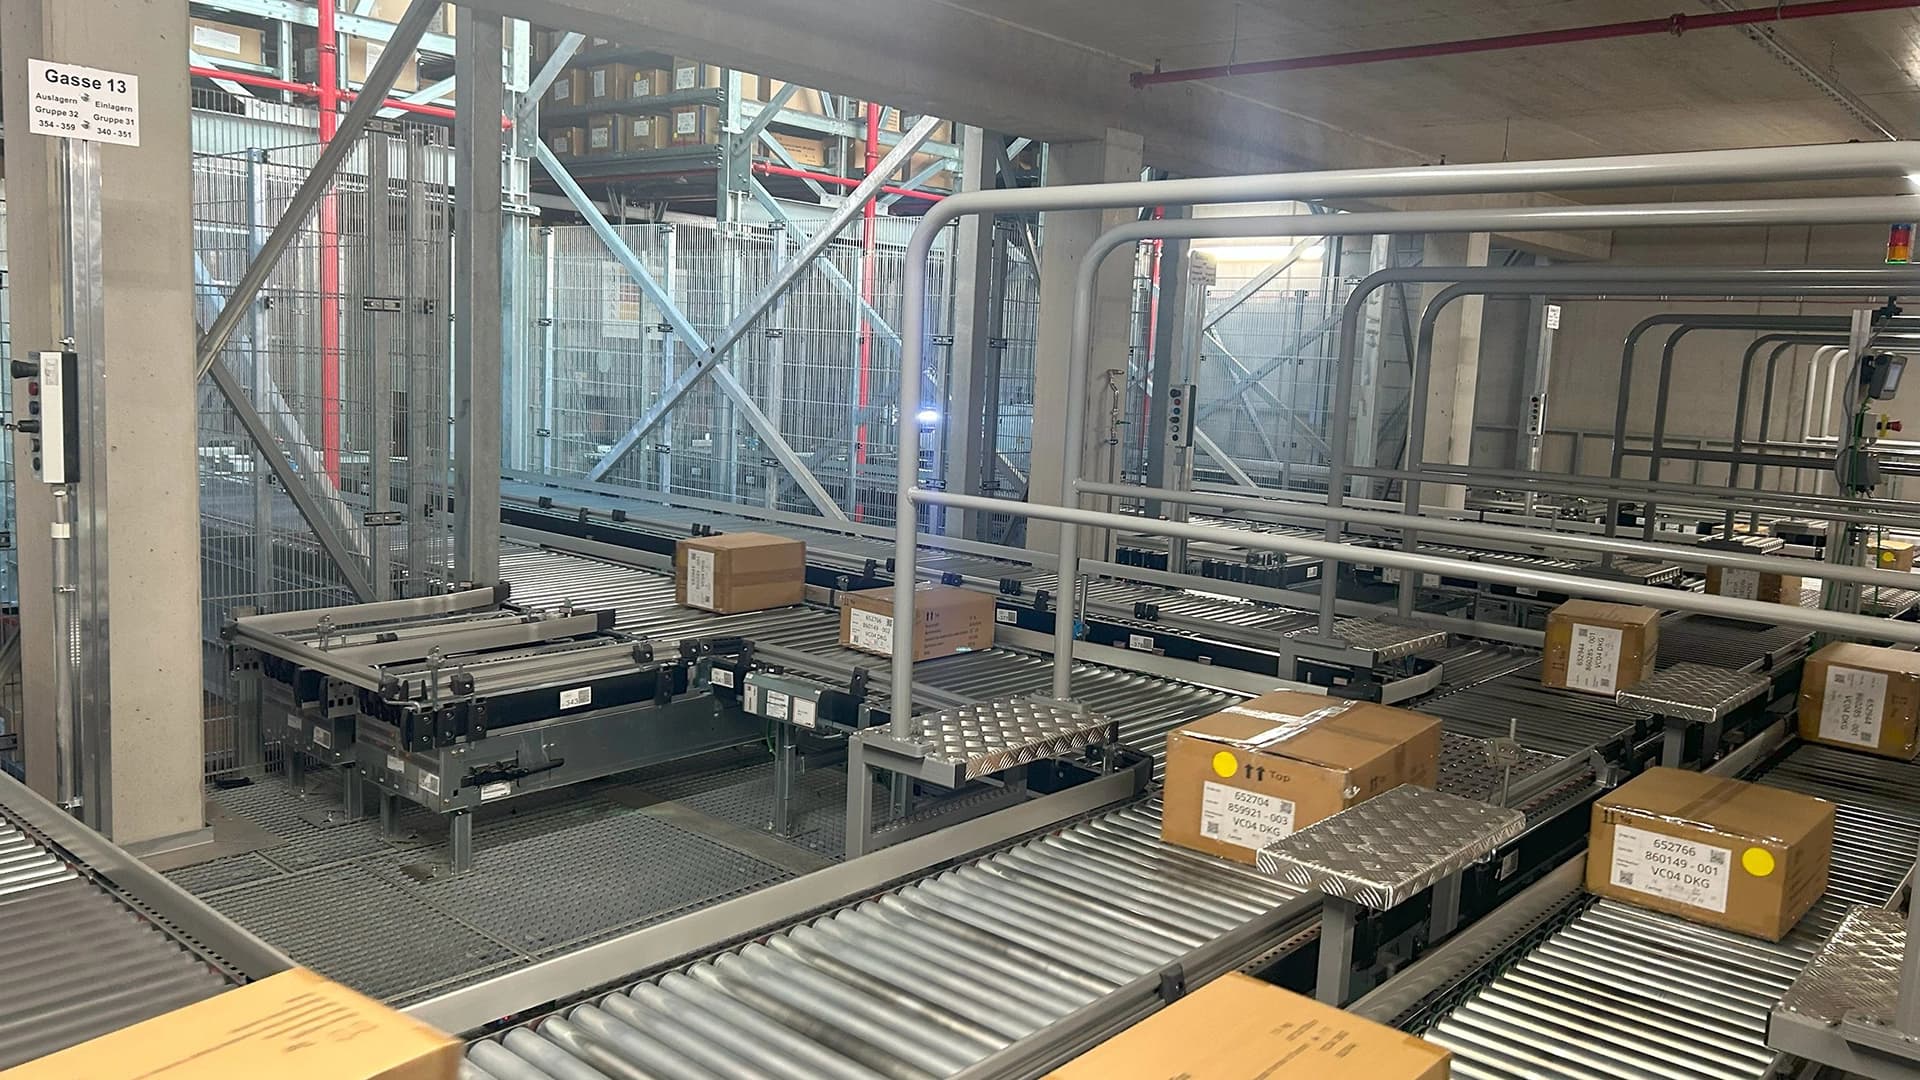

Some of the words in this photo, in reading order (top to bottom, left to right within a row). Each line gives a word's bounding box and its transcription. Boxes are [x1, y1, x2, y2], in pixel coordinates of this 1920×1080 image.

[45, 69, 102, 90] Gasse
[107, 79, 127, 93] 13
[35, 92, 78, 104] Auslagern
[35, 106, 67, 116] Gruppe
[68, 110, 79, 118] 32
[95, 101, 133, 112] Einlagern
[39, 120, 54, 128] 354
[60, 123, 76, 131] 359
[93, 114, 124, 124] Gruppe
[119, 130, 132, 138] 351
[1268, 770, 1291, 783] Top
[1234, 791, 1269, 807] 652704
[1227, 803, 1261, 818] 859921
[1270, 813, 1288, 825] 003
[1233, 817, 1257, 830] VC04
[1259, 824, 1281, 837] DKG
[1653, 839, 1696, 857] 652766
[1645, 851, 1687, 869] 860149
[1697, 863, 1718, 876] 001
[1651, 866, 1681, 881] VC04
[1684, 874, 1710, 888] DKG
